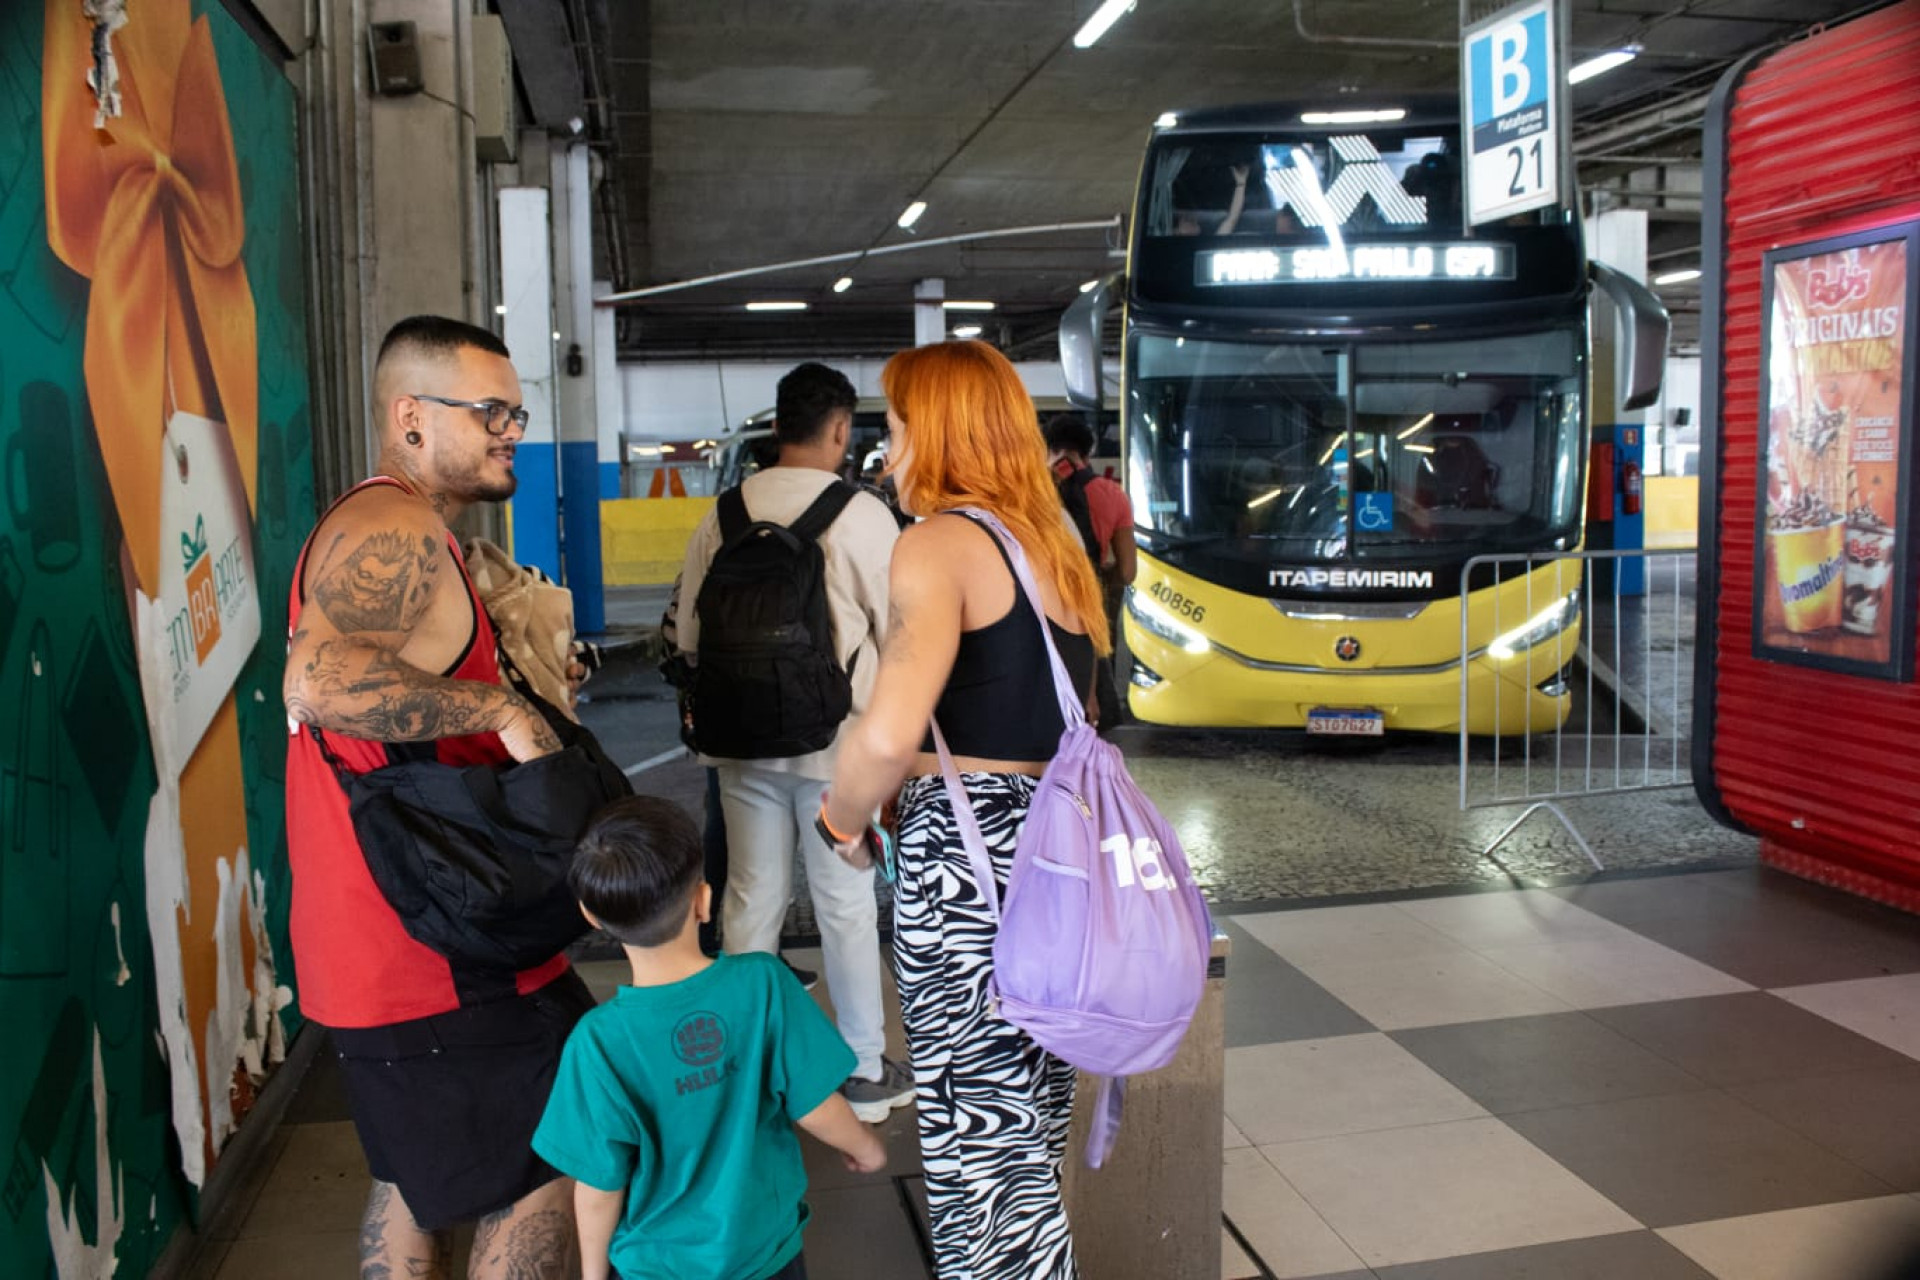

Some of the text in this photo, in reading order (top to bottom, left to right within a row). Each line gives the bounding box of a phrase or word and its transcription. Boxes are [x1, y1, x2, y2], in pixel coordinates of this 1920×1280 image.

[1491, 21, 1531, 119] B
[1497, 108, 1543, 133] Plataforma
[1507, 138, 1542, 198] 21
[1807, 265, 1871, 309] Bob's
[1269, 570, 1433, 588] ITAPEMIRIM
[1149, 580, 1206, 624] 40856
[675, 1055, 741, 1097] HULK
